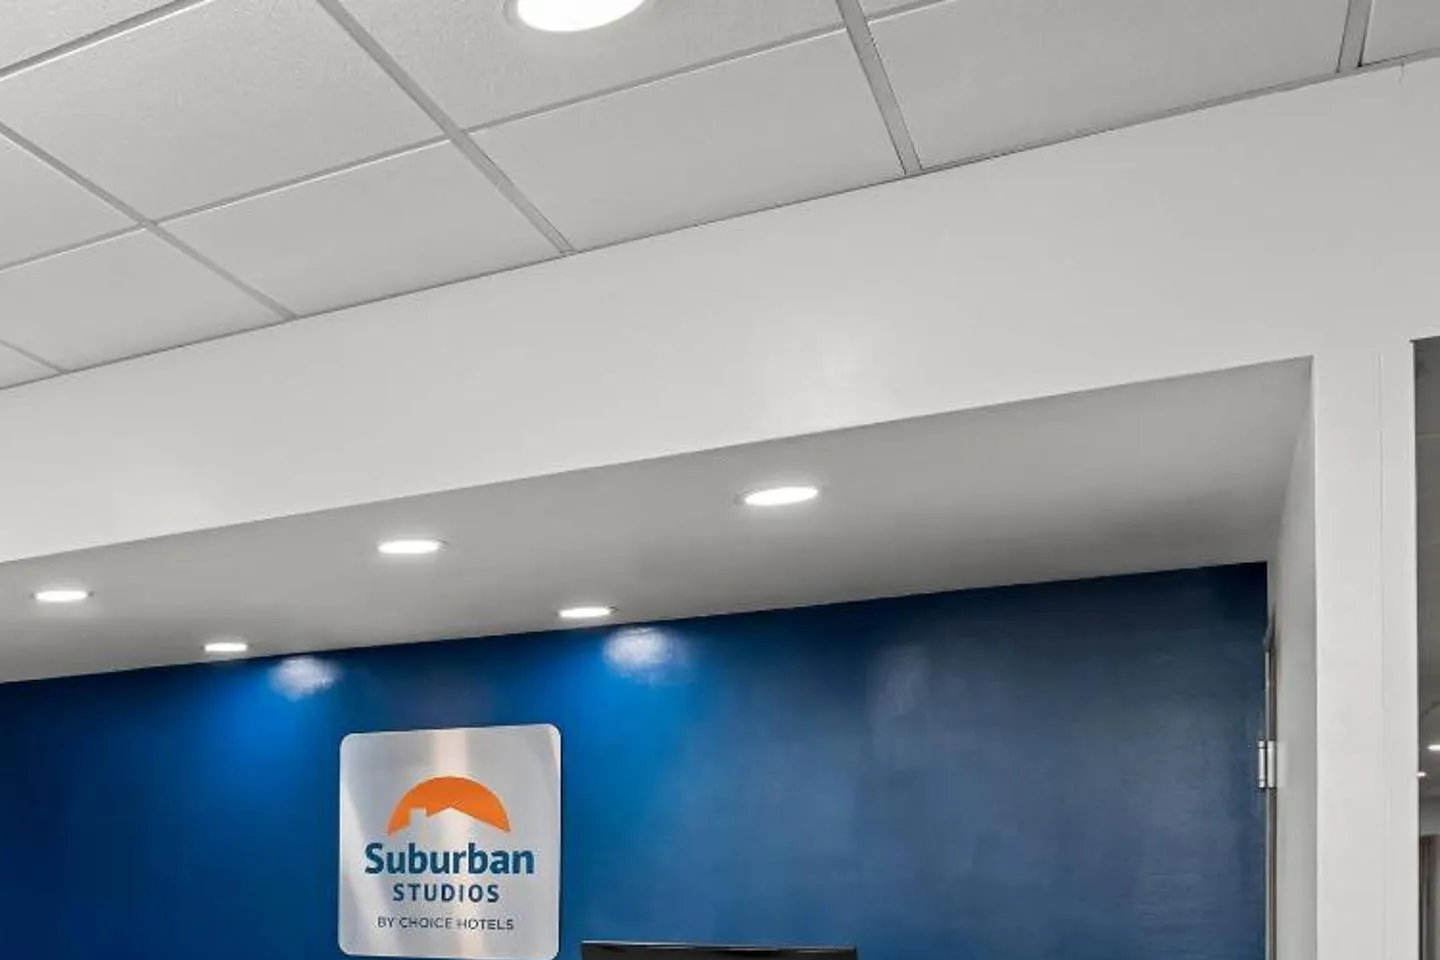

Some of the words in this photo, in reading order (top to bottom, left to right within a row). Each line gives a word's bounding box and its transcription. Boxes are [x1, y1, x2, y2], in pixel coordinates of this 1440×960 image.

[364, 842, 535, 875] Suburban
[392, 883, 499, 903] STUDIOS
[377, 917, 394, 929] BY
[399, 917, 453, 929] CHOICE
[457, 918, 514, 930] HOTELS
